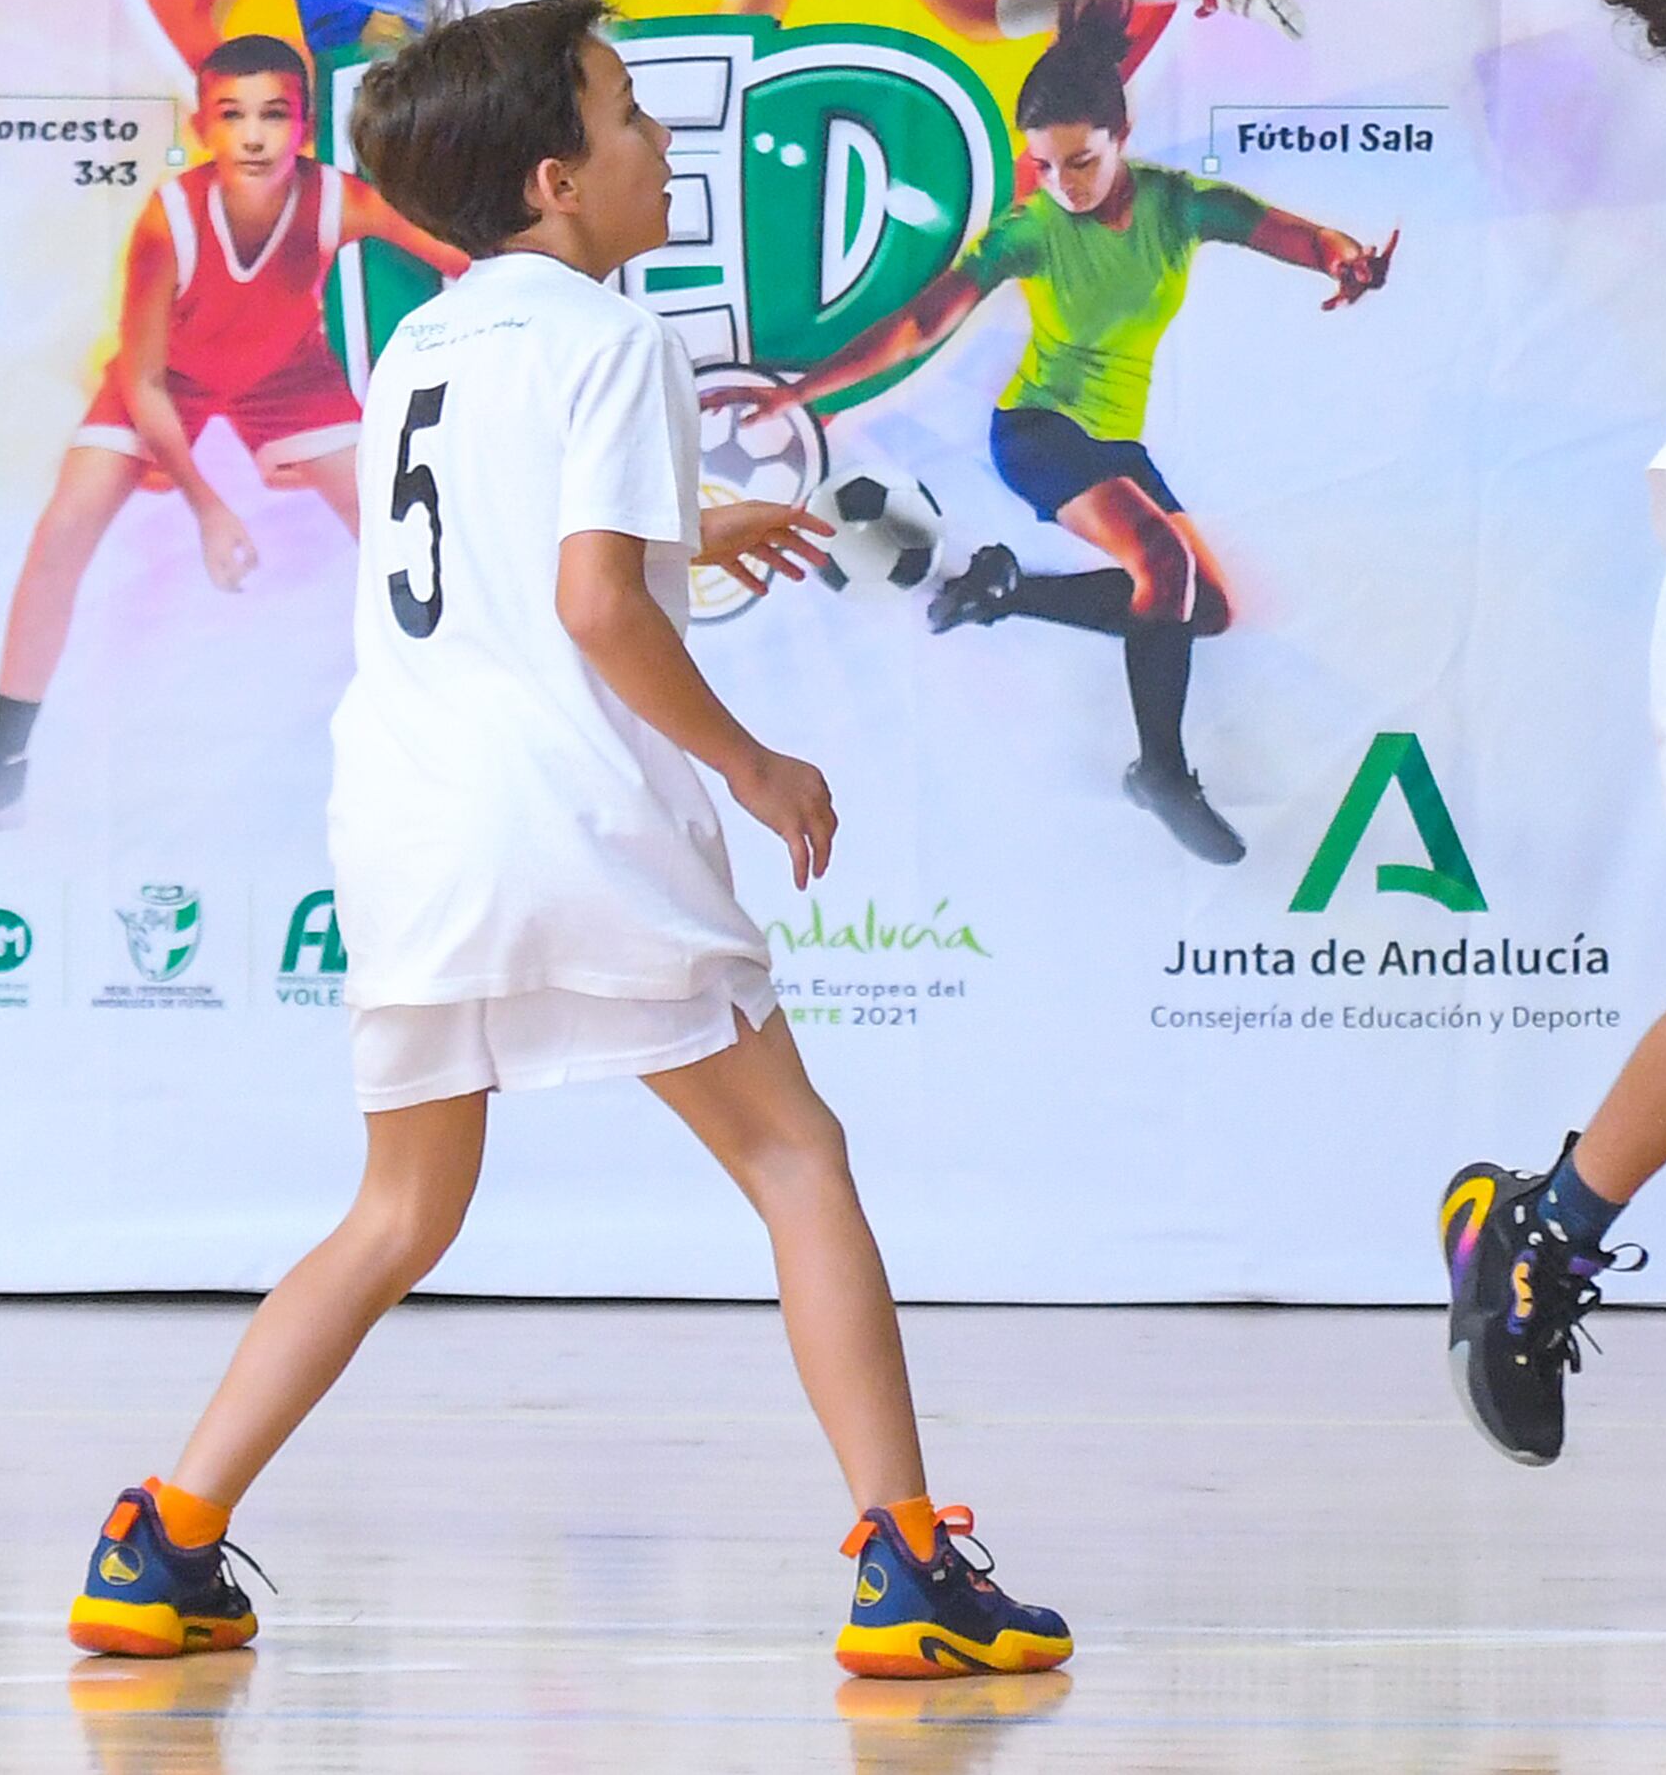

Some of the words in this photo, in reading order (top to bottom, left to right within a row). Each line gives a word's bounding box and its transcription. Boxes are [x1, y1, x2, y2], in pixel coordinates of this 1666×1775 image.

[1238, 123, 1349, 154] Fútbol
[1359, 123, 1433, 152] Sala
[76, 160, 137, 186] 3x3
[387, 381, 451, 640] 5
[763, 894, 995, 961] ndalucía
[1164, 940, 1295, 976] Junta
[1311, 938, 1366, 976] de
[1379, 932, 1609, 976] Andalucía
[277, 990, 345, 1008] VOLE
[811, 978, 917, 999] Europea
[927, 980, 965, 997] del
[853, 1006, 917, 1026] 2021
[1150, 1004, 1293, 1034] Consejería
[1300, 1005, 1334, 1029] de
[1342, 1003, 1482, 1029] Educación
[1490, 1012, 1504, 1034] y
[1512, 1005, 1620, 1033] Deporte
